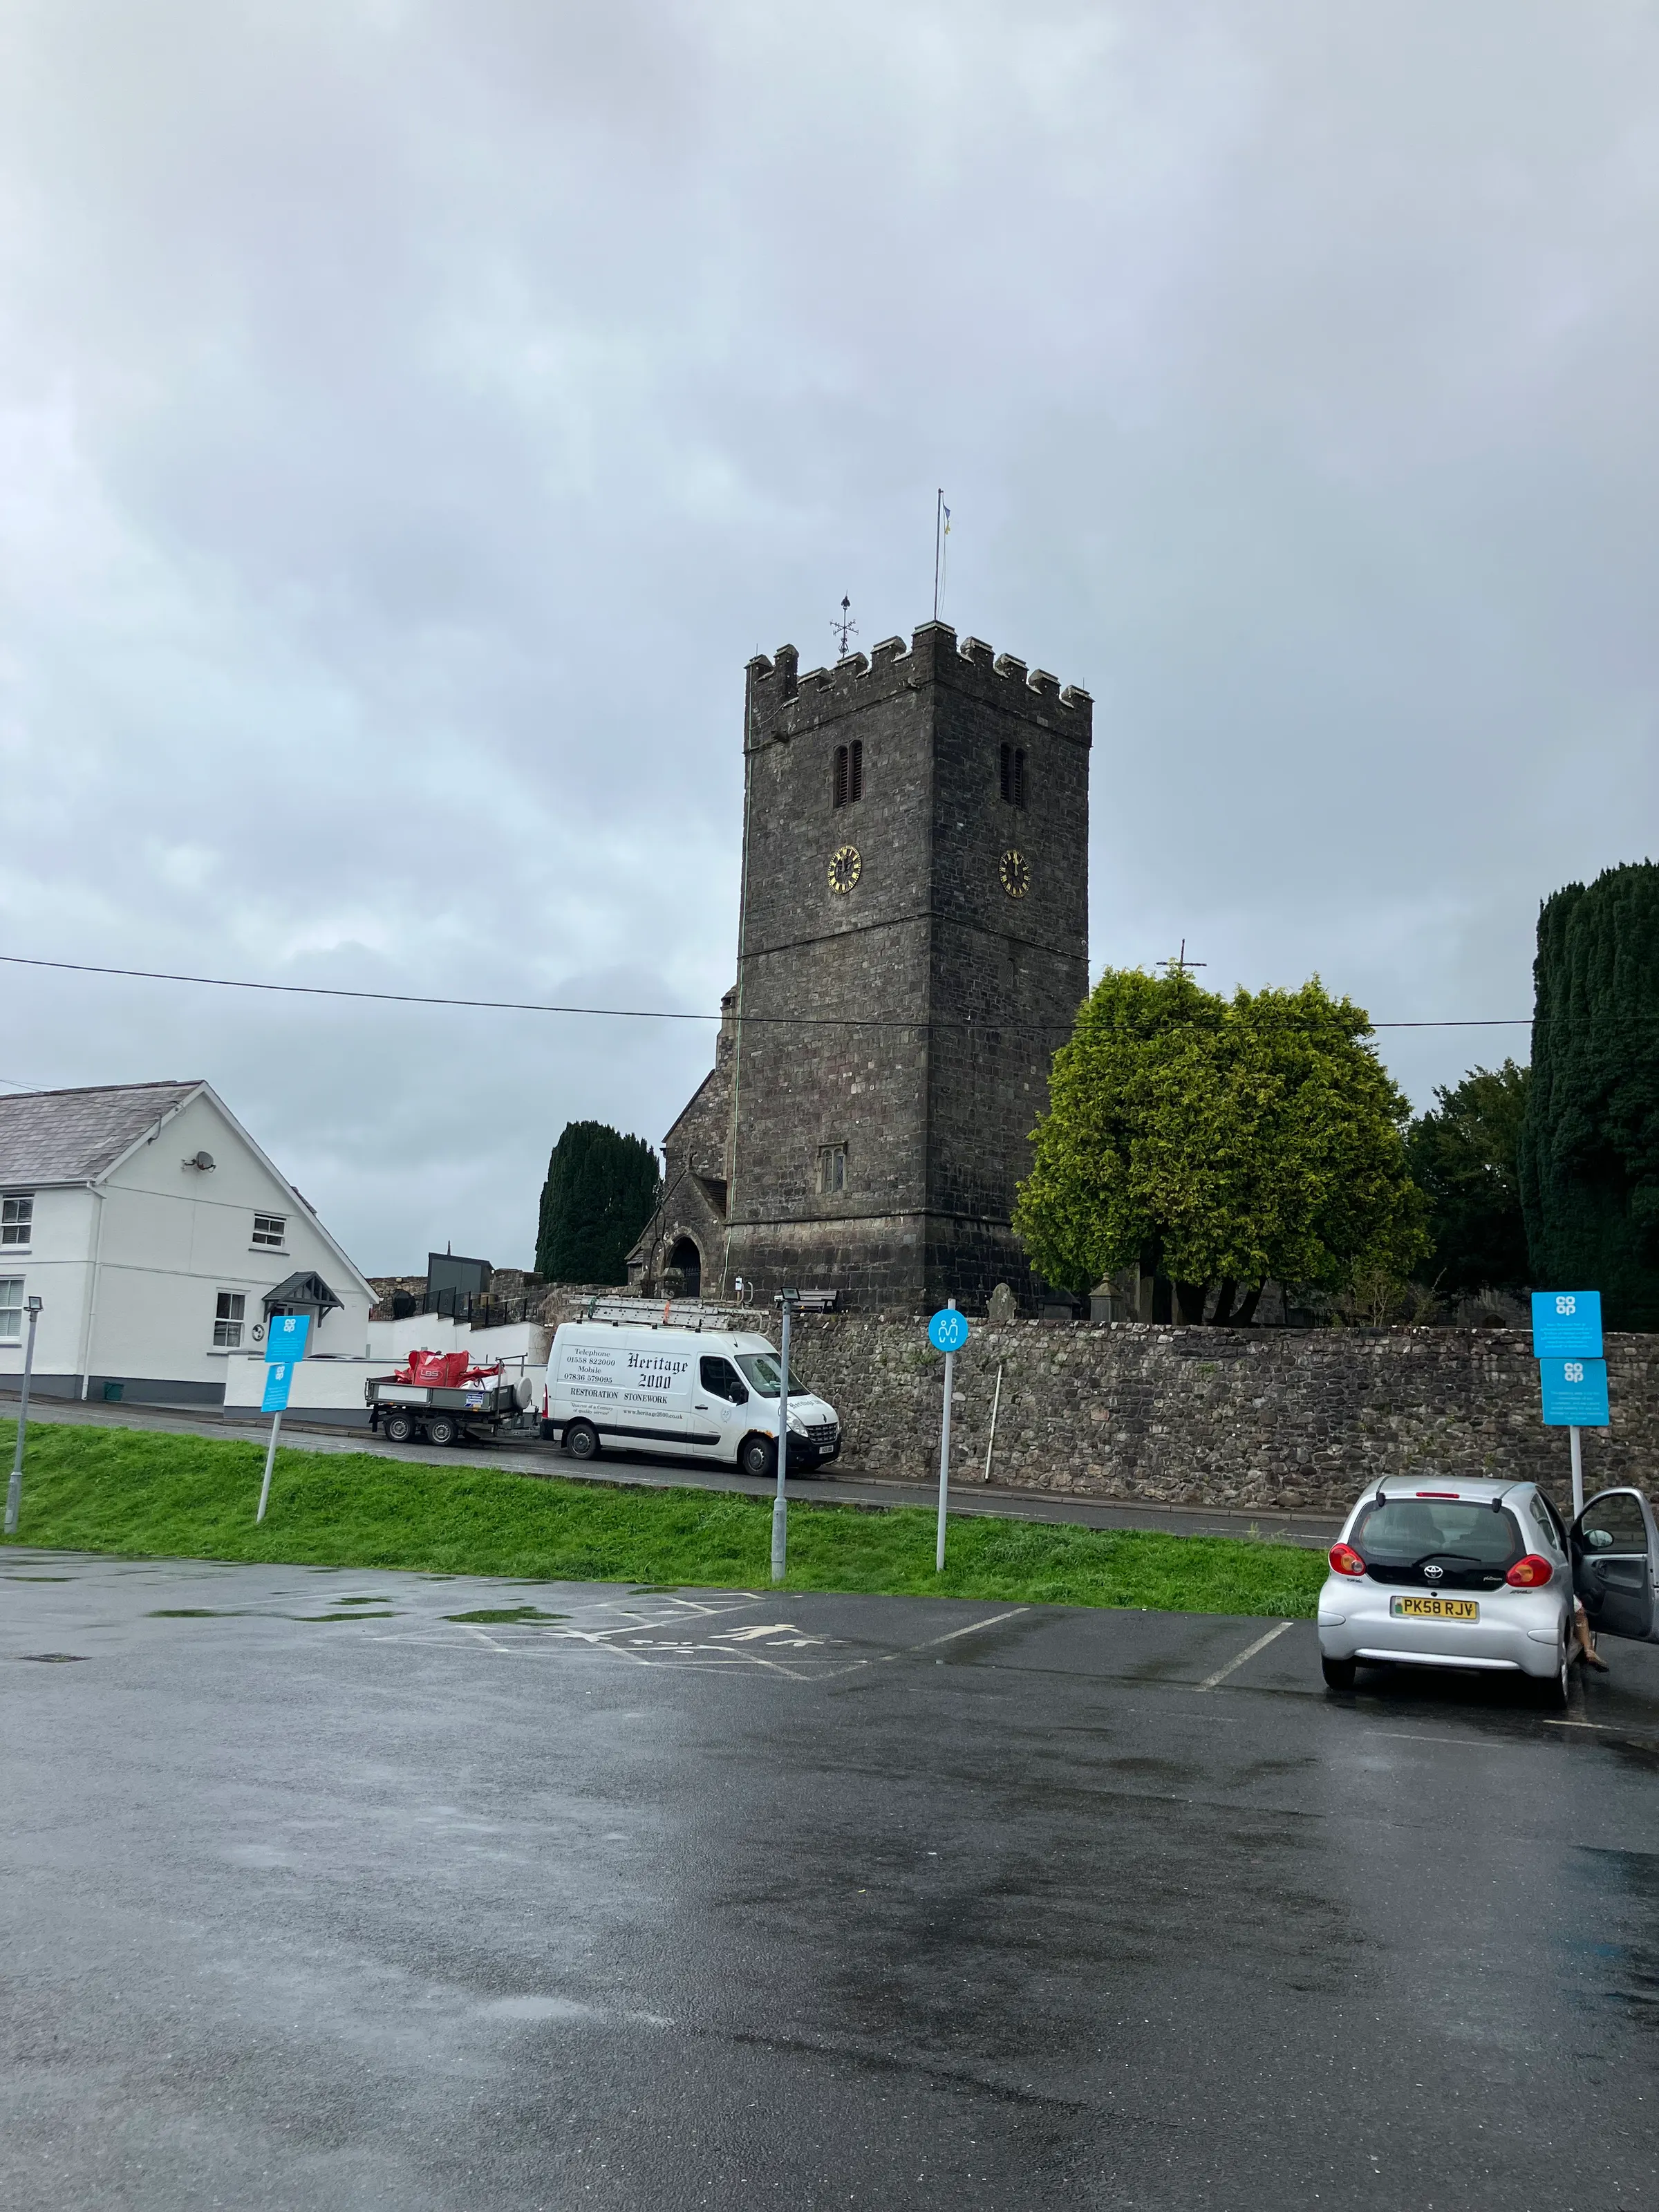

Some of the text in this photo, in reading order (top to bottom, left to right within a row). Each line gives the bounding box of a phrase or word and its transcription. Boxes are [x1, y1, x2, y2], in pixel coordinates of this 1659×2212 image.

[575, 1348, 610, 1357] Telephone
[588, 1358, 615, 1366] 822000
[627, 1352, 688, 1374] Heritage
[578, 1365, 601, 1374] Mobile
[587, 1375, 612, 1383] 579095
[638, 1374, 671, 1389] 2000
[570, 1387, 668, 1404] RESTORATION STONEWORK
[623, 1409, 684, 1419] www.heritage2000.co.uk
[1404, 1599, 1472, 1616] PK58 RJV
